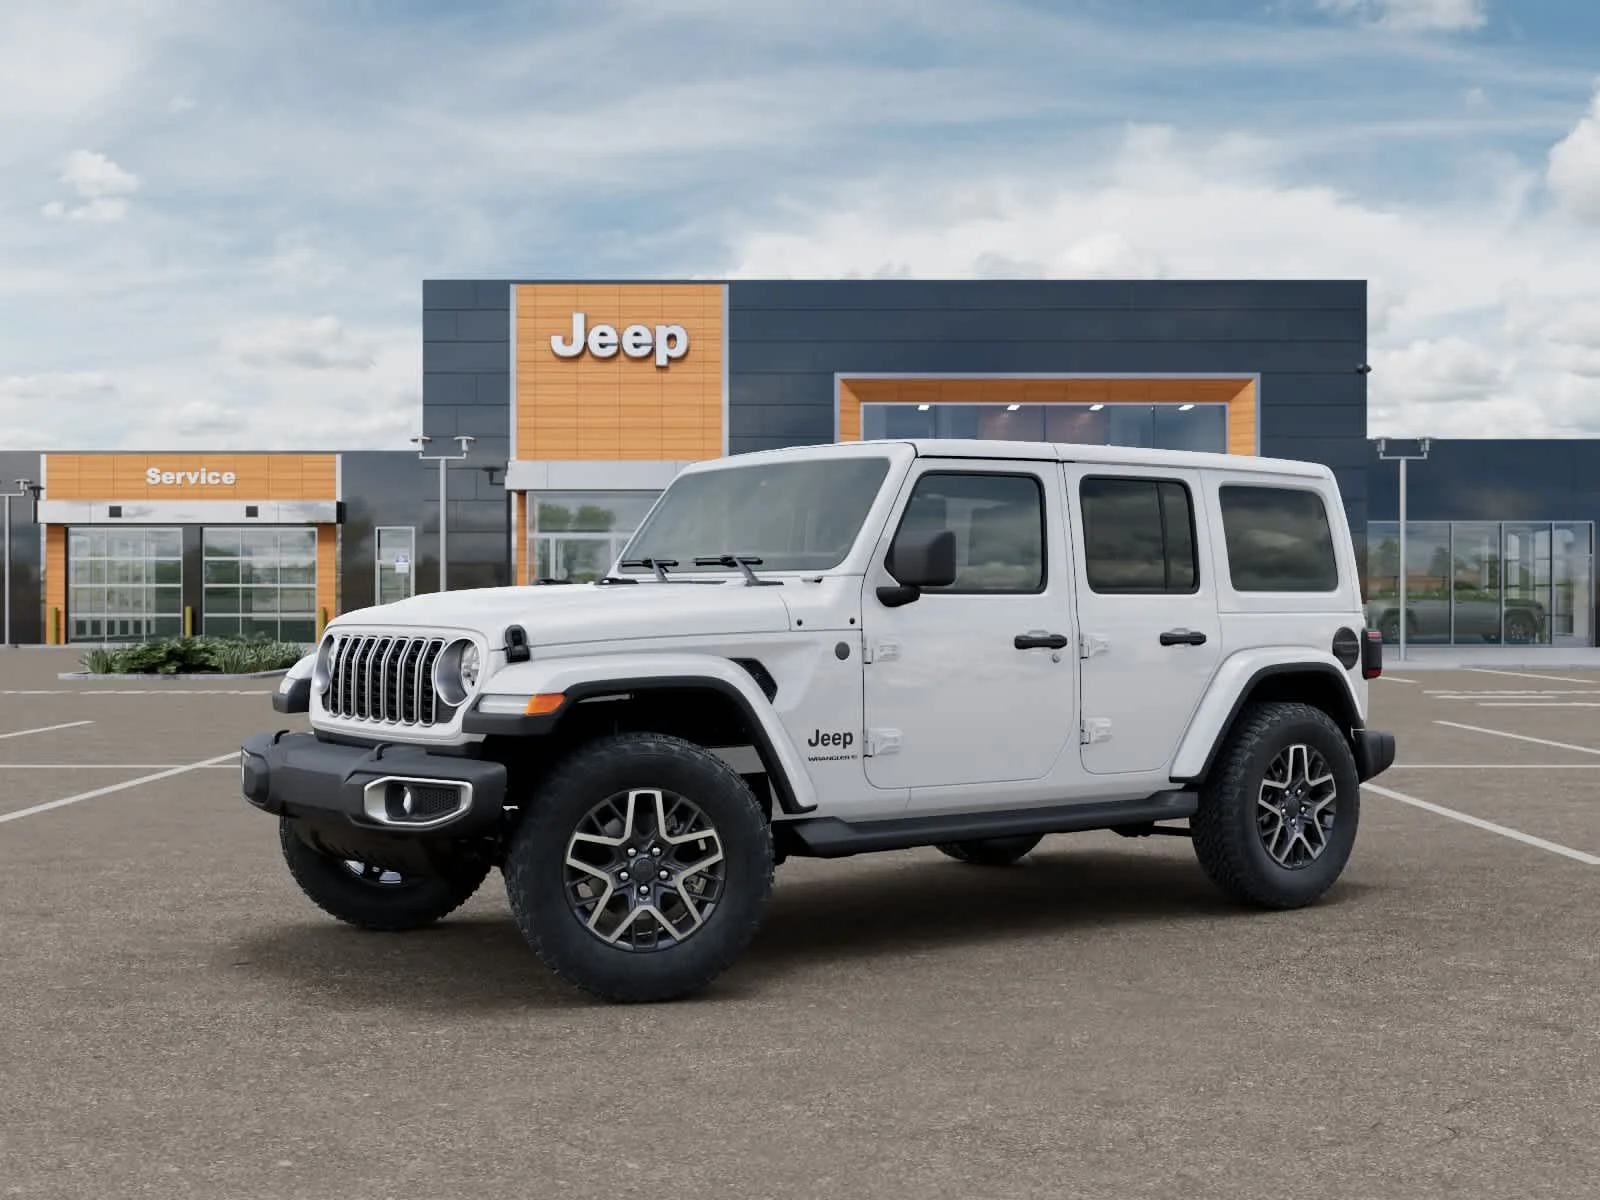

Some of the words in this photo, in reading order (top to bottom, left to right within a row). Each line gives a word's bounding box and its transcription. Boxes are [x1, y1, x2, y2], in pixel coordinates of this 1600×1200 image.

[550, 311, 690, 368] Jeep
[146, 467, 236, 486] Service
[807, 728, 854, 749] Jeep
